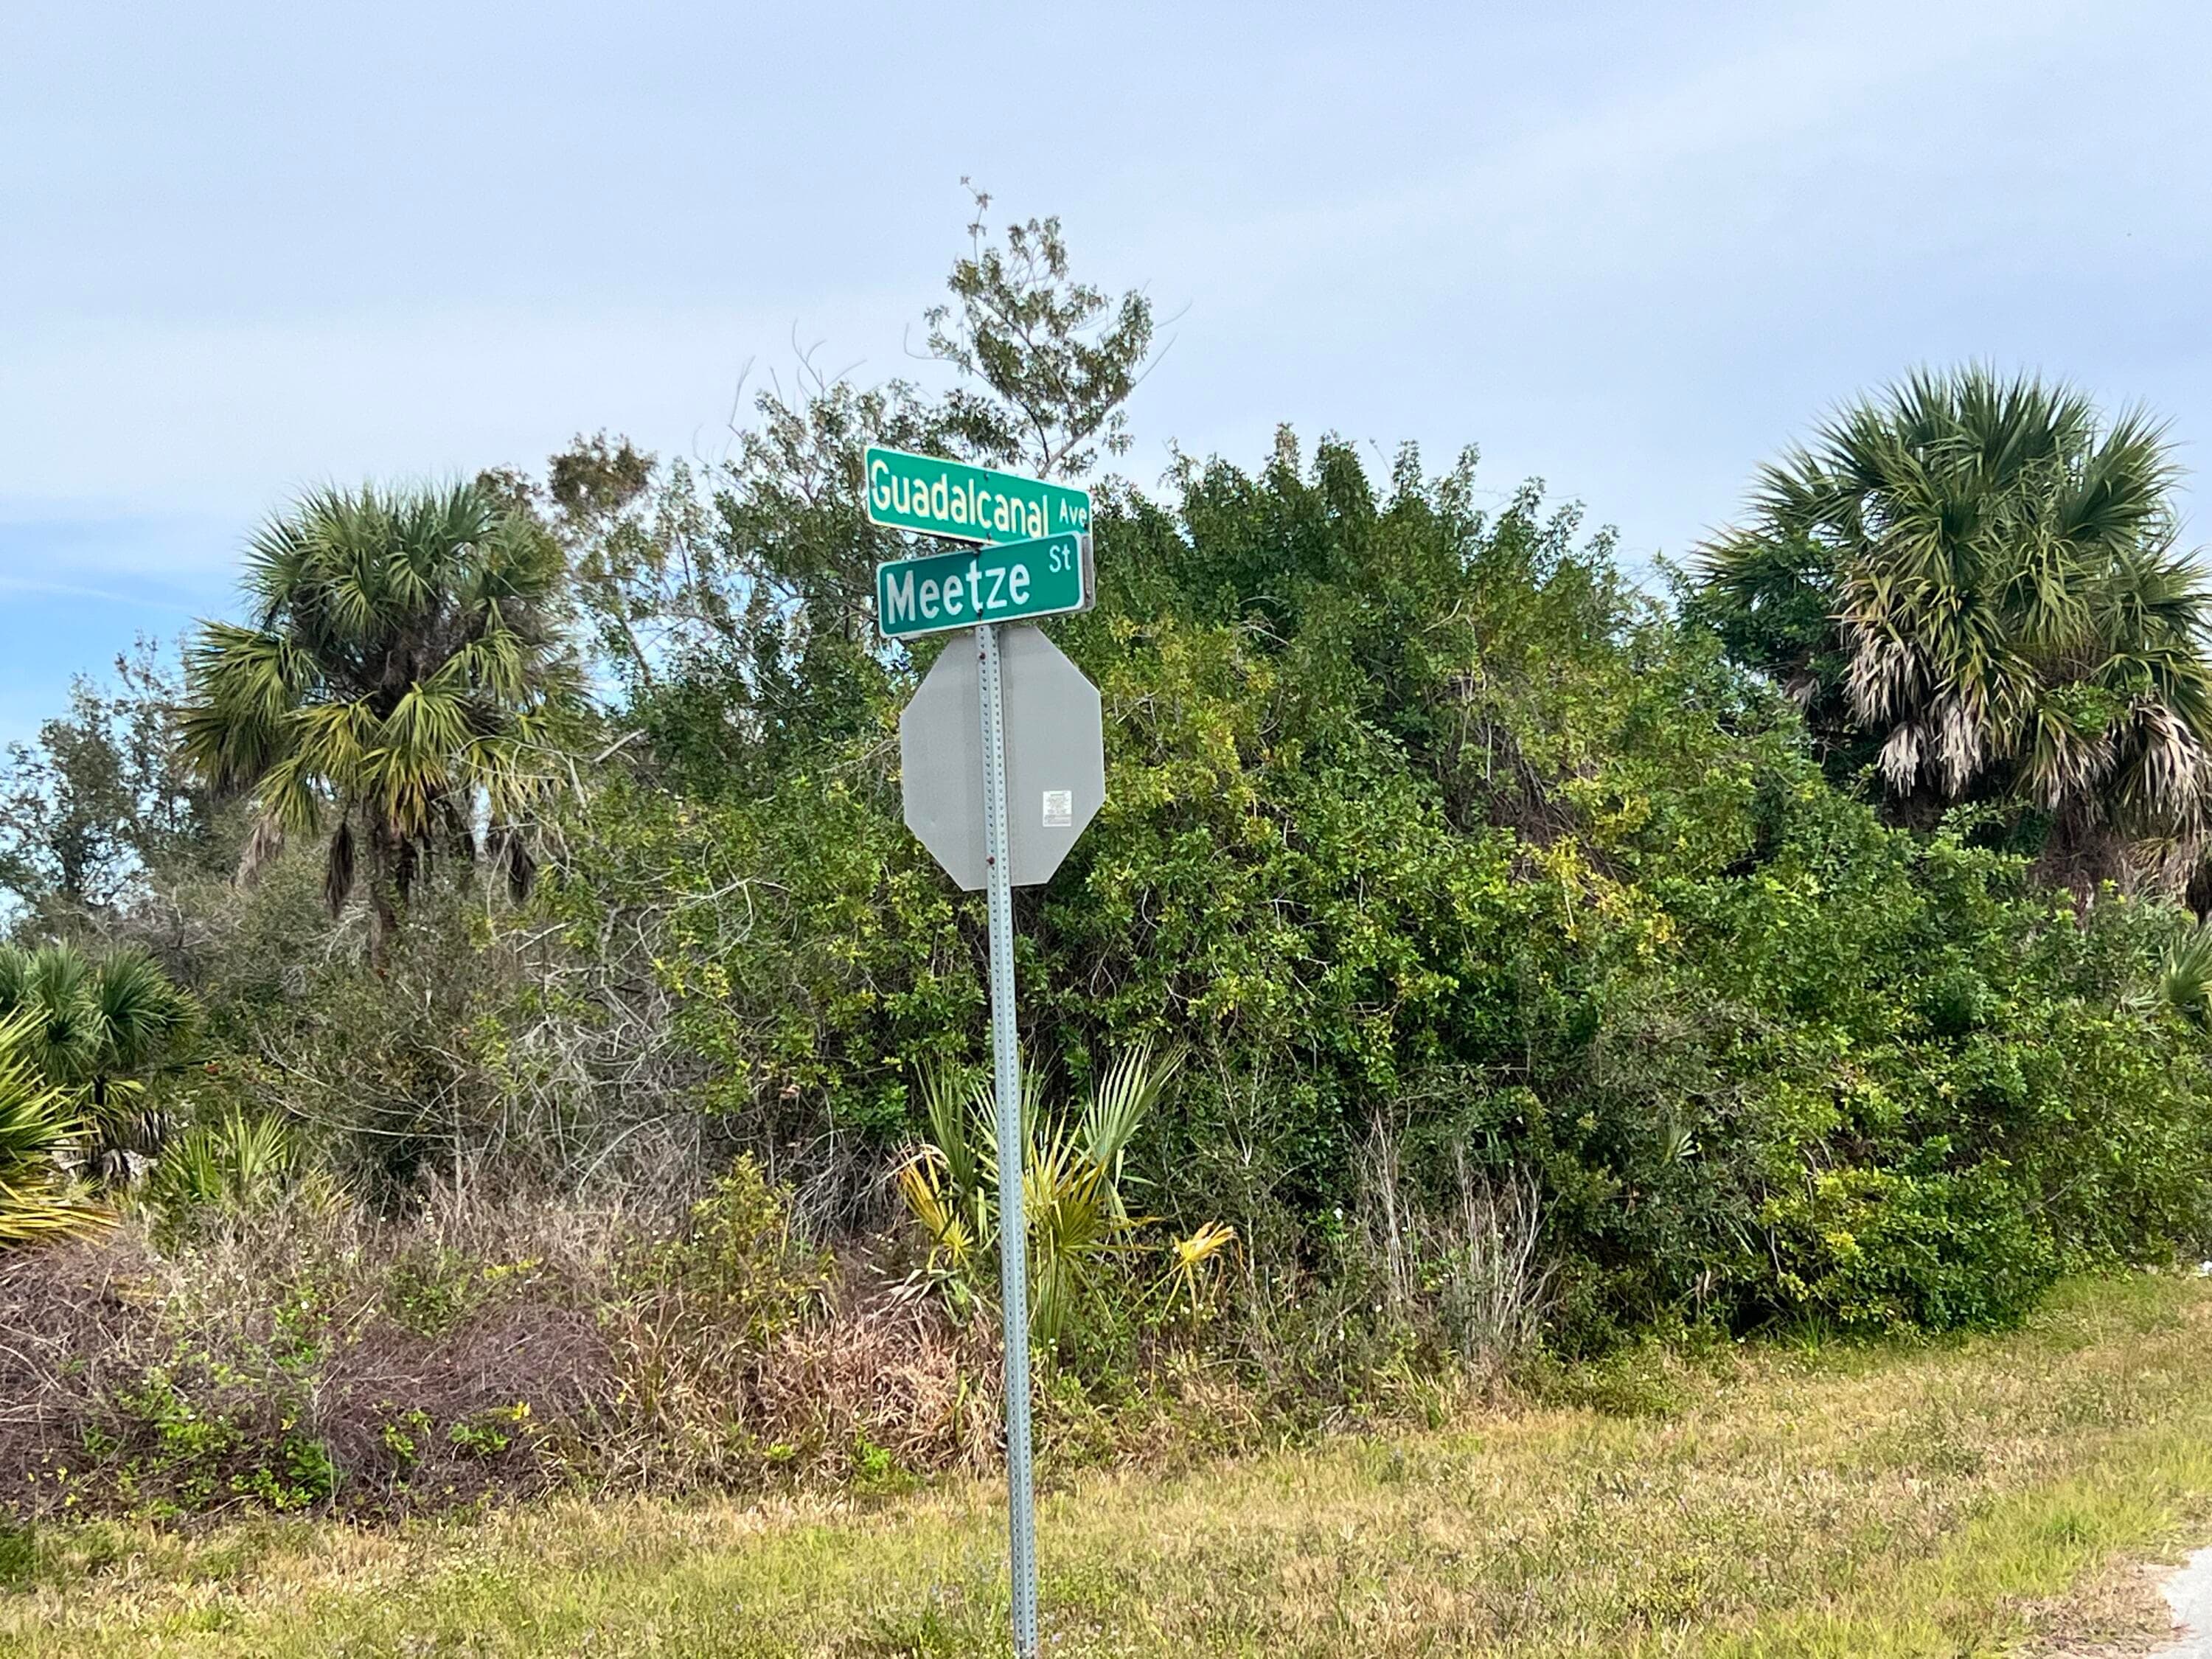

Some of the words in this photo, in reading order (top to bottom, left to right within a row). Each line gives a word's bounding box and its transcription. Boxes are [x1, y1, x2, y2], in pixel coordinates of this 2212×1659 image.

[871, 459, 1048, 538] Guadalcanal
[1059, 498, 1088, 527] Ave
[886, 560, 1030, 625] Meetze
[1048, 544, 1071, 573] St
